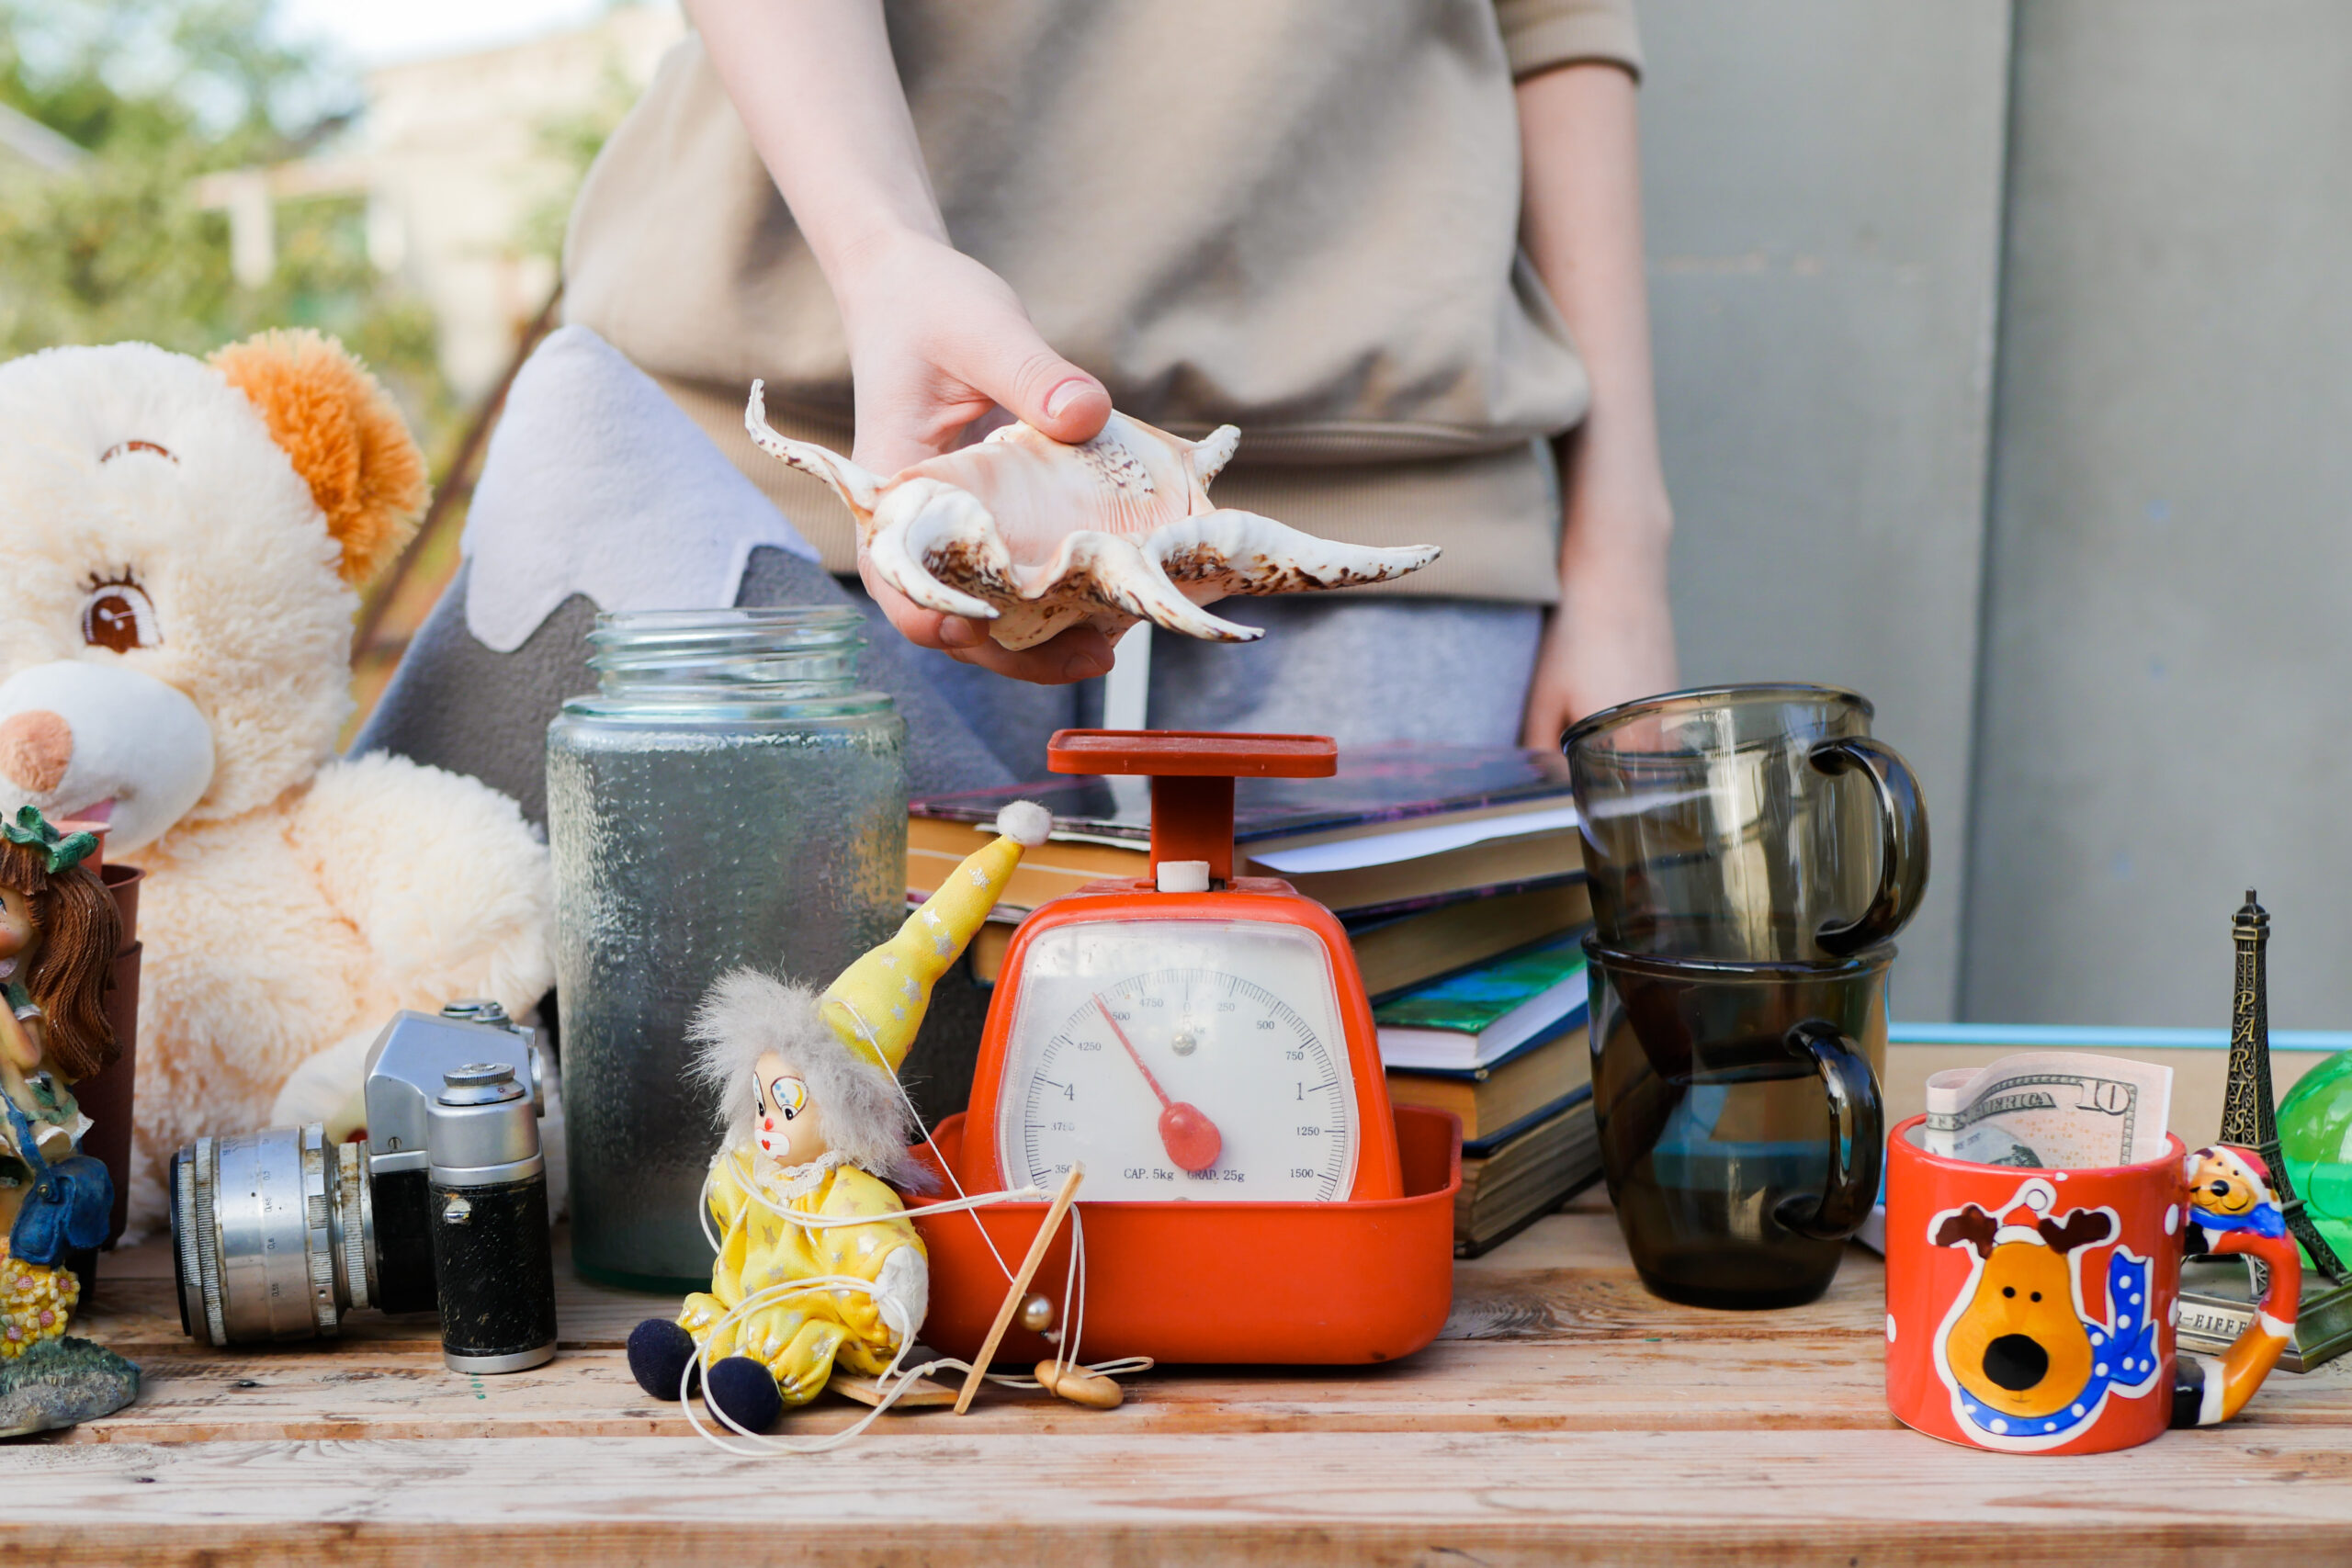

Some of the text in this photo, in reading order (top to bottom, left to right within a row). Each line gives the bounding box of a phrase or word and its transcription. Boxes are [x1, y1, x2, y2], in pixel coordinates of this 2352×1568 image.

[1138, 998, 1164, 1009] 4750
[1216, 1001, 1236, 1012] 250
[1110, 1011, 1131, 1022] 500
[1255, 1020, 1275, 1031] 500
[1076, 1042, 1102, 1052] 4250
[1285, 1050, 1305, 1061] 750
[2227, 991, 2256, 1135] PARIS
[1063, 1083, 1075, 1101] 4
[1295, 1081, 1304, 1101] 1
[2075, 1080, 2132, 1117] 10
[1296, 1126, 1320, 1137] 1250
[1054, 1164, 1073, 1175] 350
[1290, 1168, 1315, 1179] 1500
[1124, 1168, 1246, 1183] CAP. 5kg GRAD. 25g
